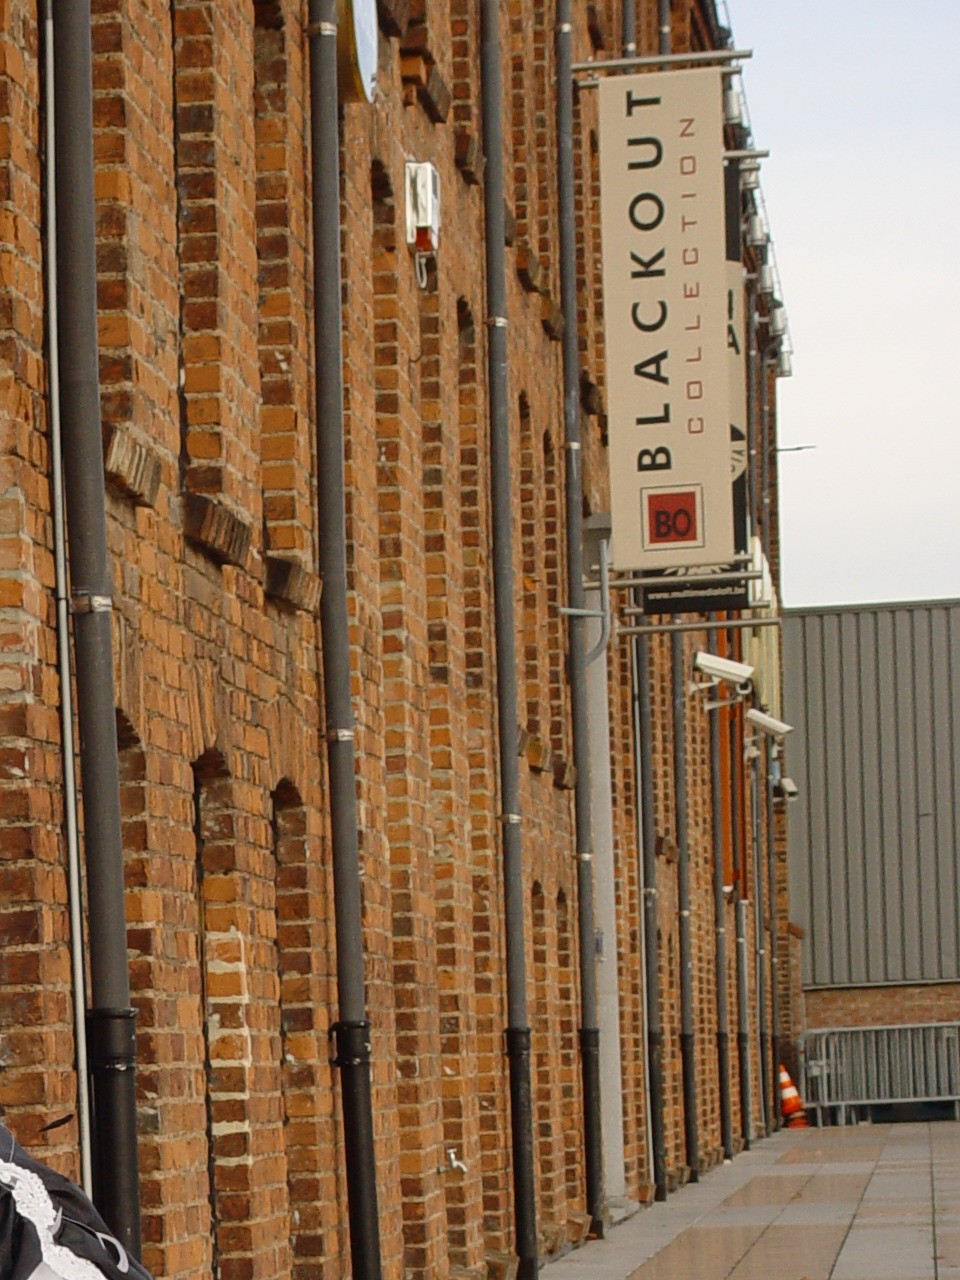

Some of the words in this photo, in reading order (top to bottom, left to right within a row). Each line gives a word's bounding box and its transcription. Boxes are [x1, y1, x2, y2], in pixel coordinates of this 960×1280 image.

[625, 89, 672, 472] BLACKOUT
[679, 117, 705, 434] COLLECTION
[654, 507, 692, 539] BO
